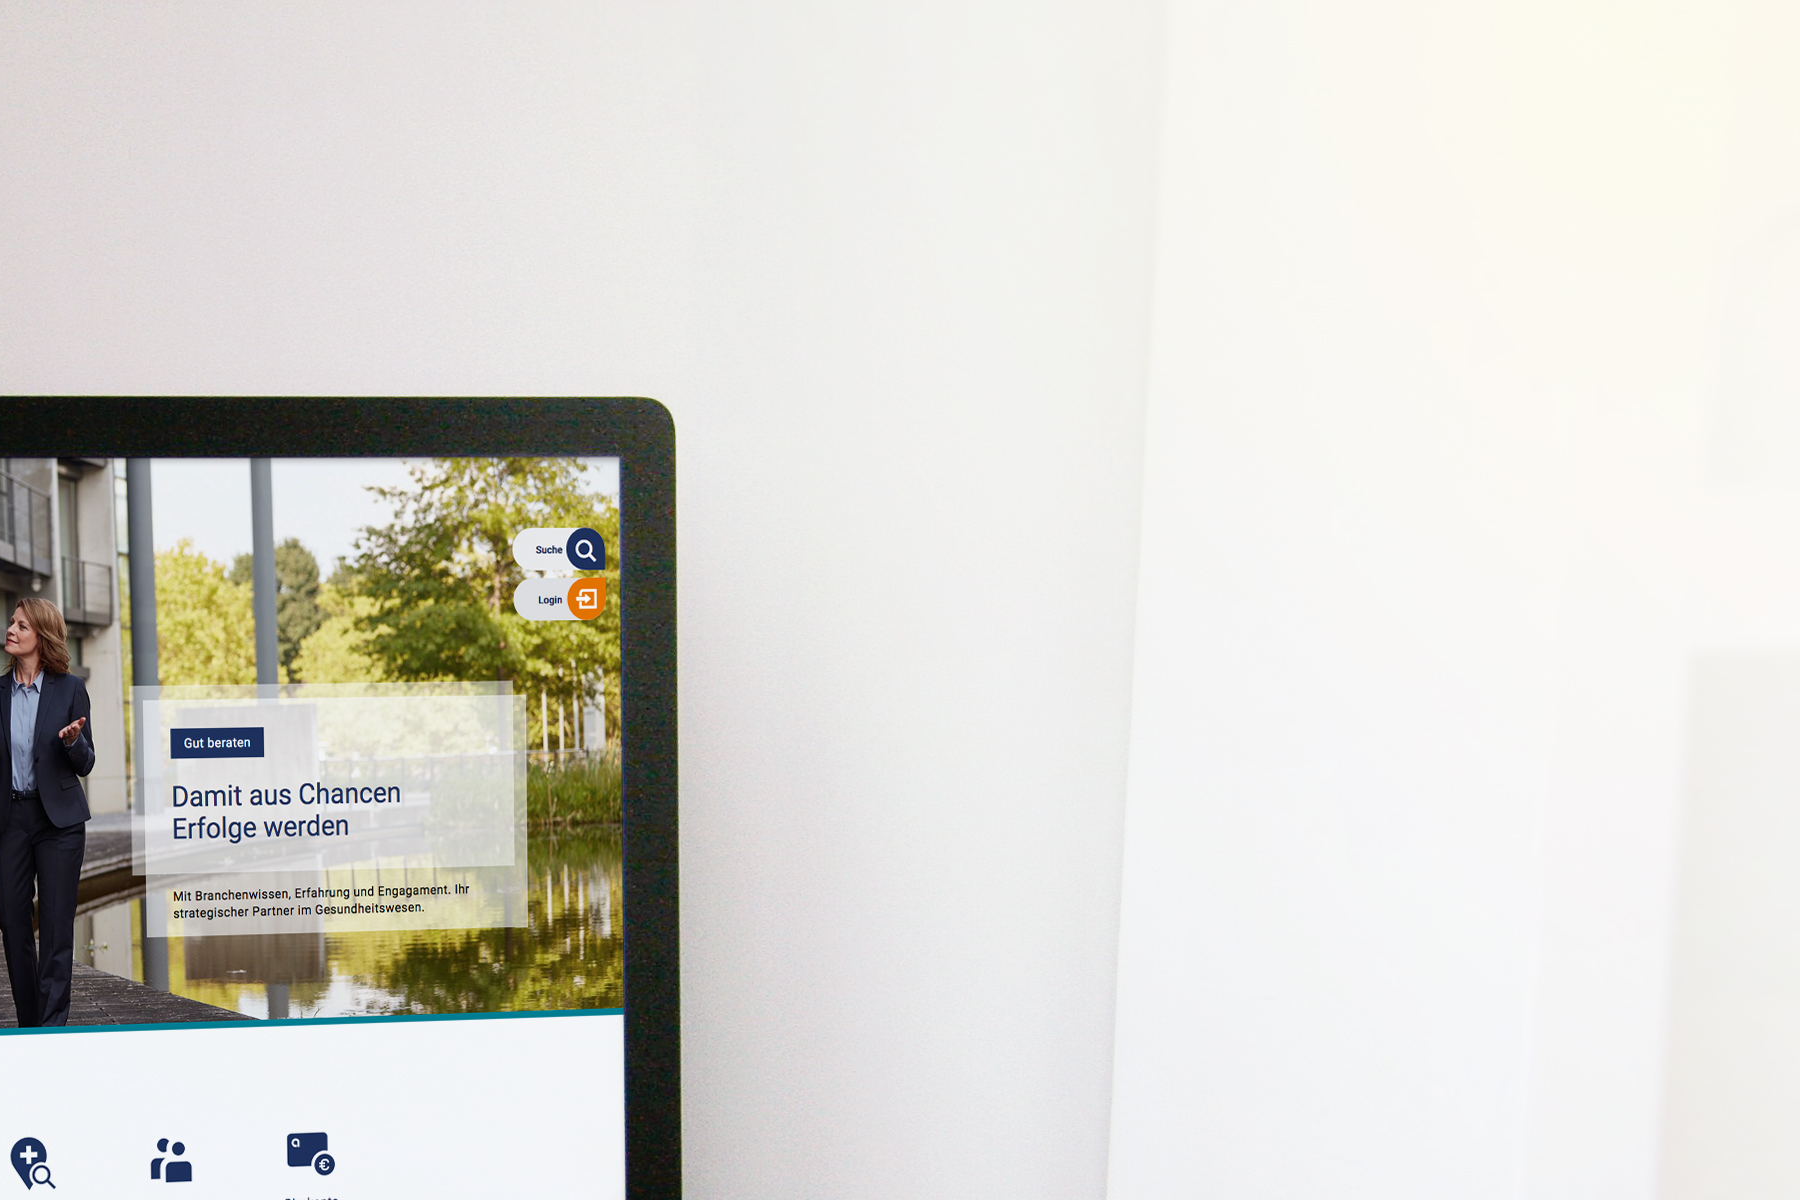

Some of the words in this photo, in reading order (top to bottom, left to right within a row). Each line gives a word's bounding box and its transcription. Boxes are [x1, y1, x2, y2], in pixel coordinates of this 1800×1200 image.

[536, 546, 562, 554] Suche
[538, 596, 562, 606] Login
[183, 737, 204, 749] Gut
[208, 737, 251, 749] beraten
[172, 784, 242, 808] Damit
[250, 787, 291, 806] aus
[299, 782, 402, 805] Chancen
[172, 816, 257, 844] Erfolge
[264, 815, 350, 837] werden
[173, 891, 191, 901] Mit
[195, 889, 291, 901] Branchenwissen,
[295, 887, 350, 899] Erfahrung
[353, 886, 374, 896] und
[378, 885, 451, 898] Engagament.
[455, 884, 469, 894] Ihr
[173, 907, 249, 920] strategischer
[252, 906, 294, 916] Partner
[298, 905, 312, 915] im
[316, 904, 425, 915] Gesundheitswesen.
